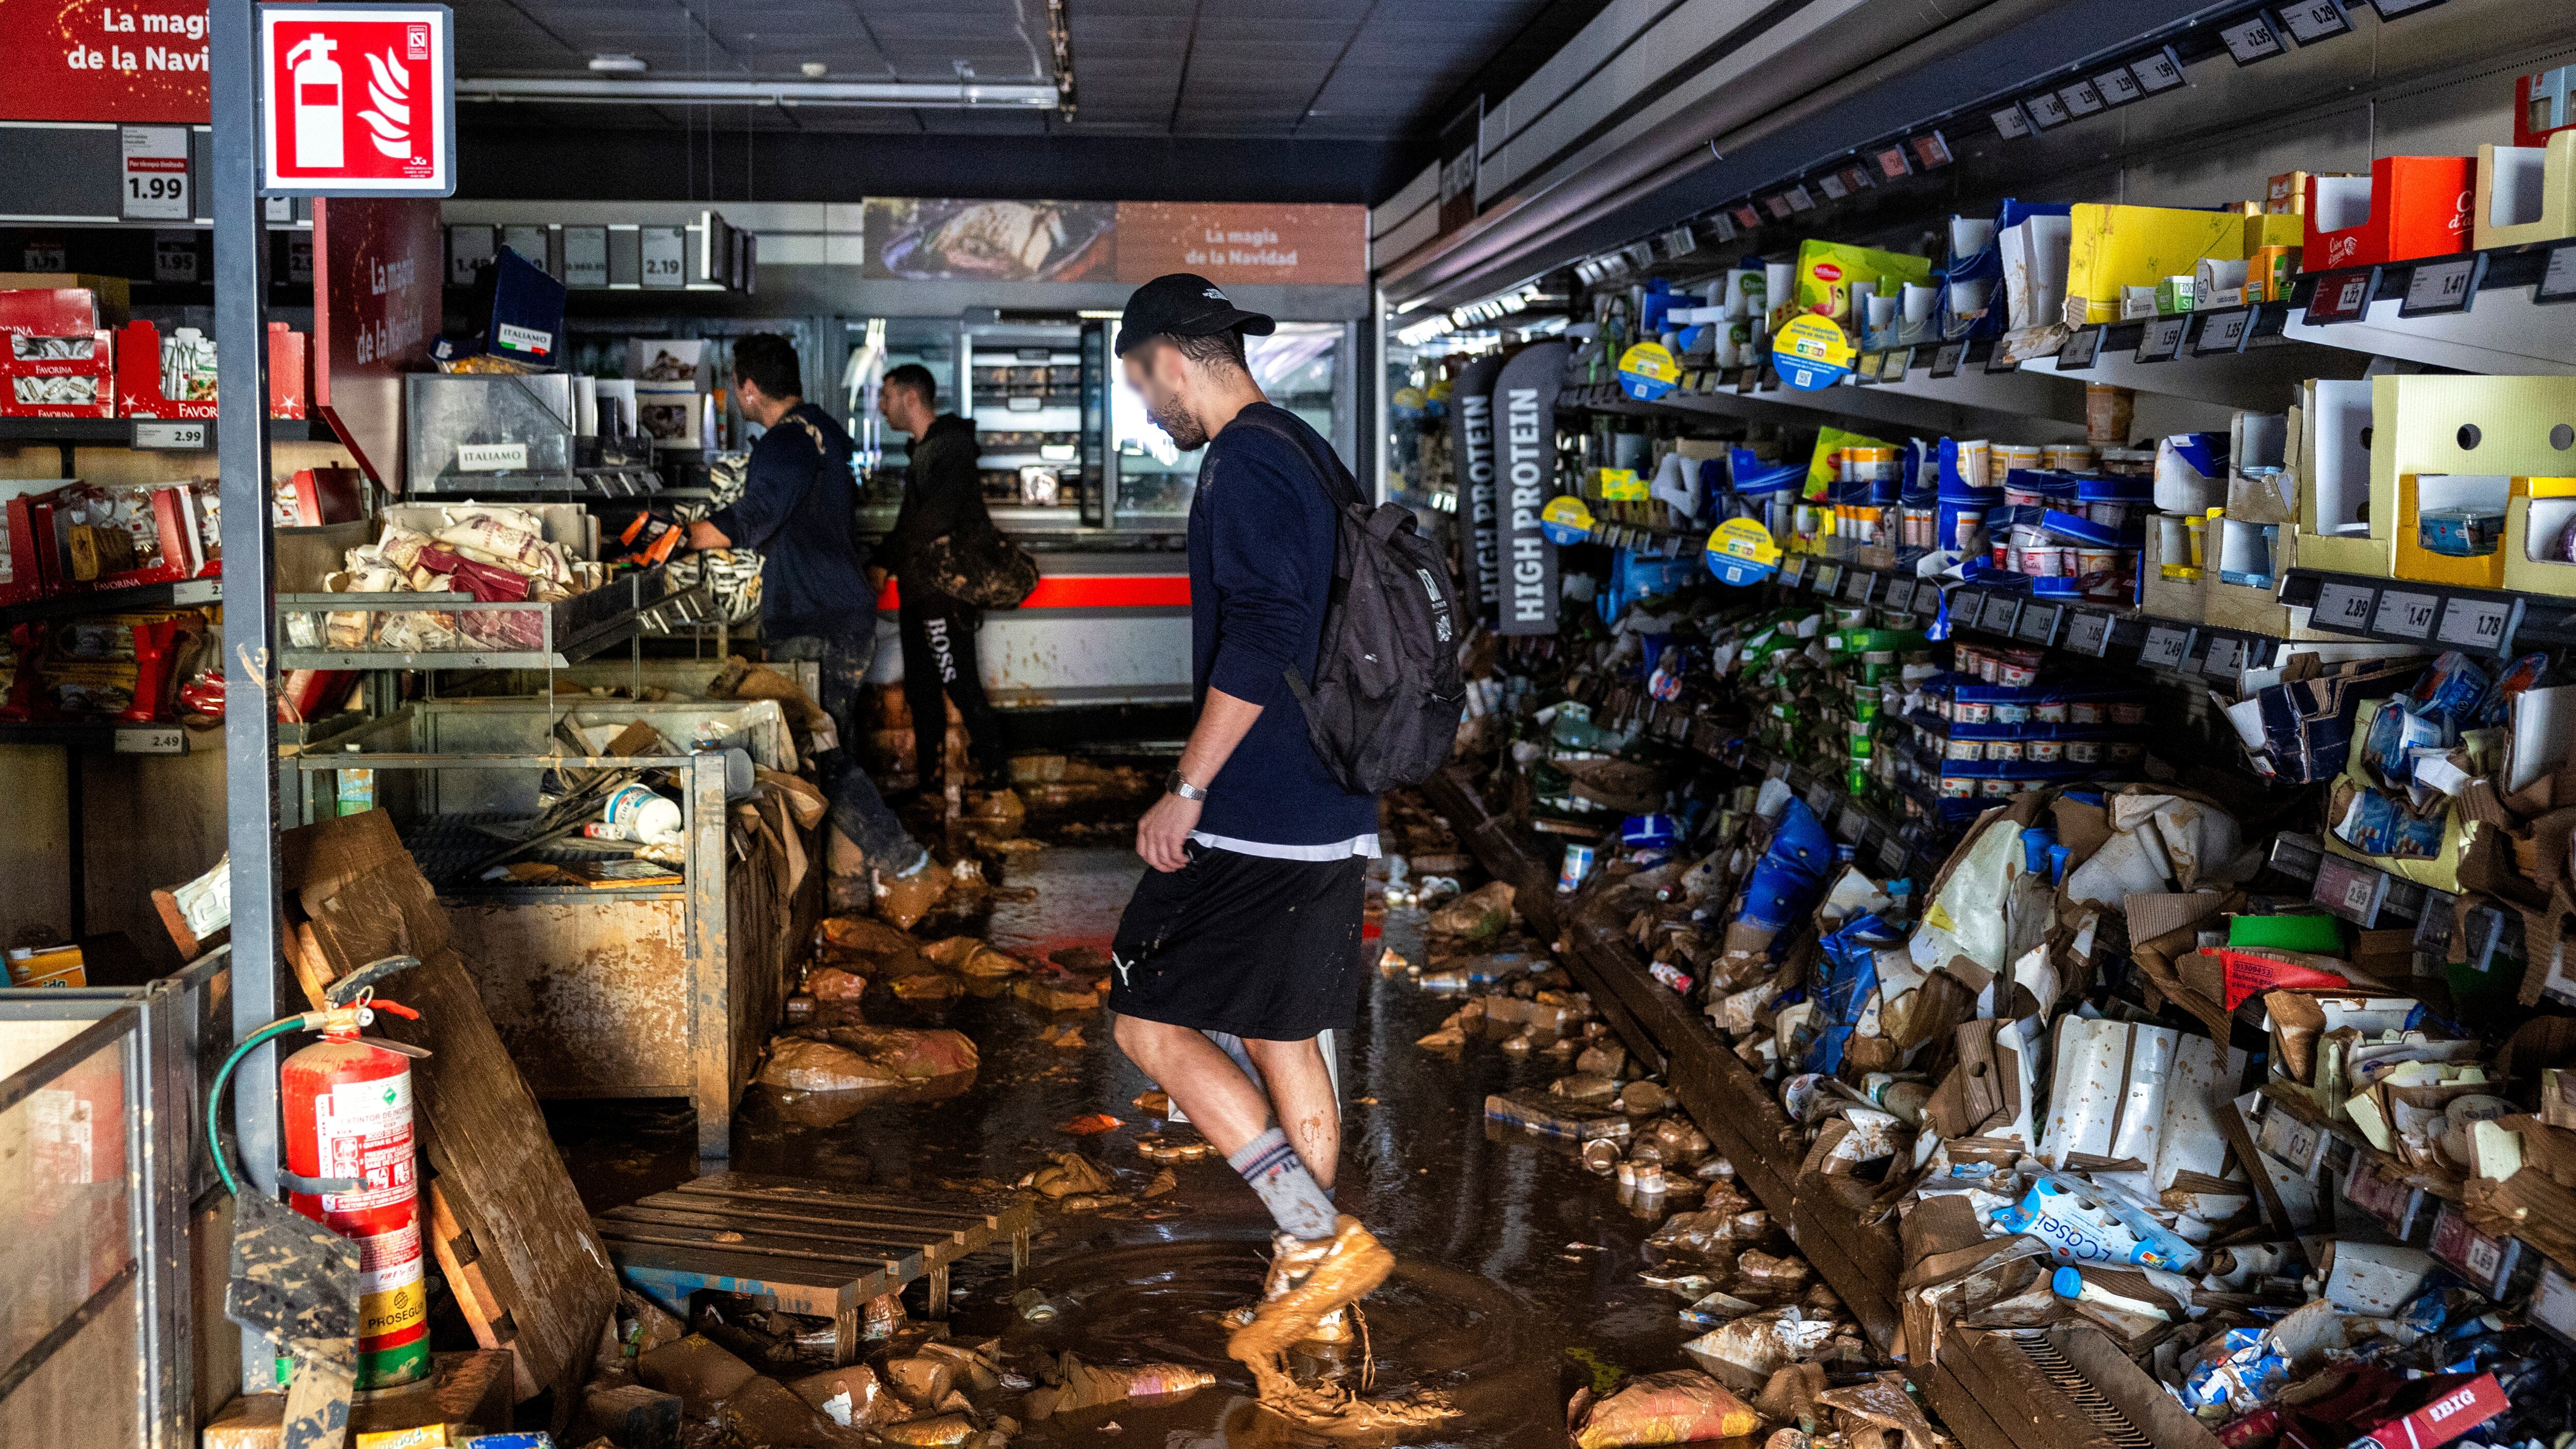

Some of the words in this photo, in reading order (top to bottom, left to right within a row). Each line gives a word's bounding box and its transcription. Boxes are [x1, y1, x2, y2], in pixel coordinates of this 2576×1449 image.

[104, 8, 135, 32] La
[2312, 5, 2336, 24] 0.29
[68, 45, 103, 70] de
[112, 45, 138, 71] la
[146, 46, 210, 71] Navi
[2155, 62, 2175, 79] 1.99
[129, 178, 182, 199] 1.99
[1206, 229, 1224, 243] La
[1228, 228, 1278, 247] magia
[647, 259, 679, 274] 2.19
[1186, 249, 1206, 264] de
[1210, 249, 1225, 265] la
[1229, 249, 1298, 265] Navidad
[371, 257, 386, 296] La
[2443, 274, 2465, 295] 1.41
[2343, 290, 2359, 305] 1.22
[357, 323, 374, 364] de
[376, 319, 386, 359] la
[503, 328, 547, 344] ITALIAMO
[36, 365, 73, 374] FAVORINA
[38, 410, 75, 418] FAVORINA
[178, 403, 218, 418] FAVOR
[175, 431, 200, 441] 2.99
[464, 451, 521, 462] ITALIAMO
[1462, 395, 1495, 524] PROTEIN
[1508, 388, 1541, 531] PROTEIN
[94, 578, 141, 591] FAVORINA
[1514, 537, 1545, 622] HIGH
[2345, 598, 2369, 618] 2.89
[2408, 606, 2431, 628] 1.47
[2476, 614, 2501, 636] 1.78
[152, 736, 179, 746] 2.49
[2035, 1216, 2098, 1259] Casei
